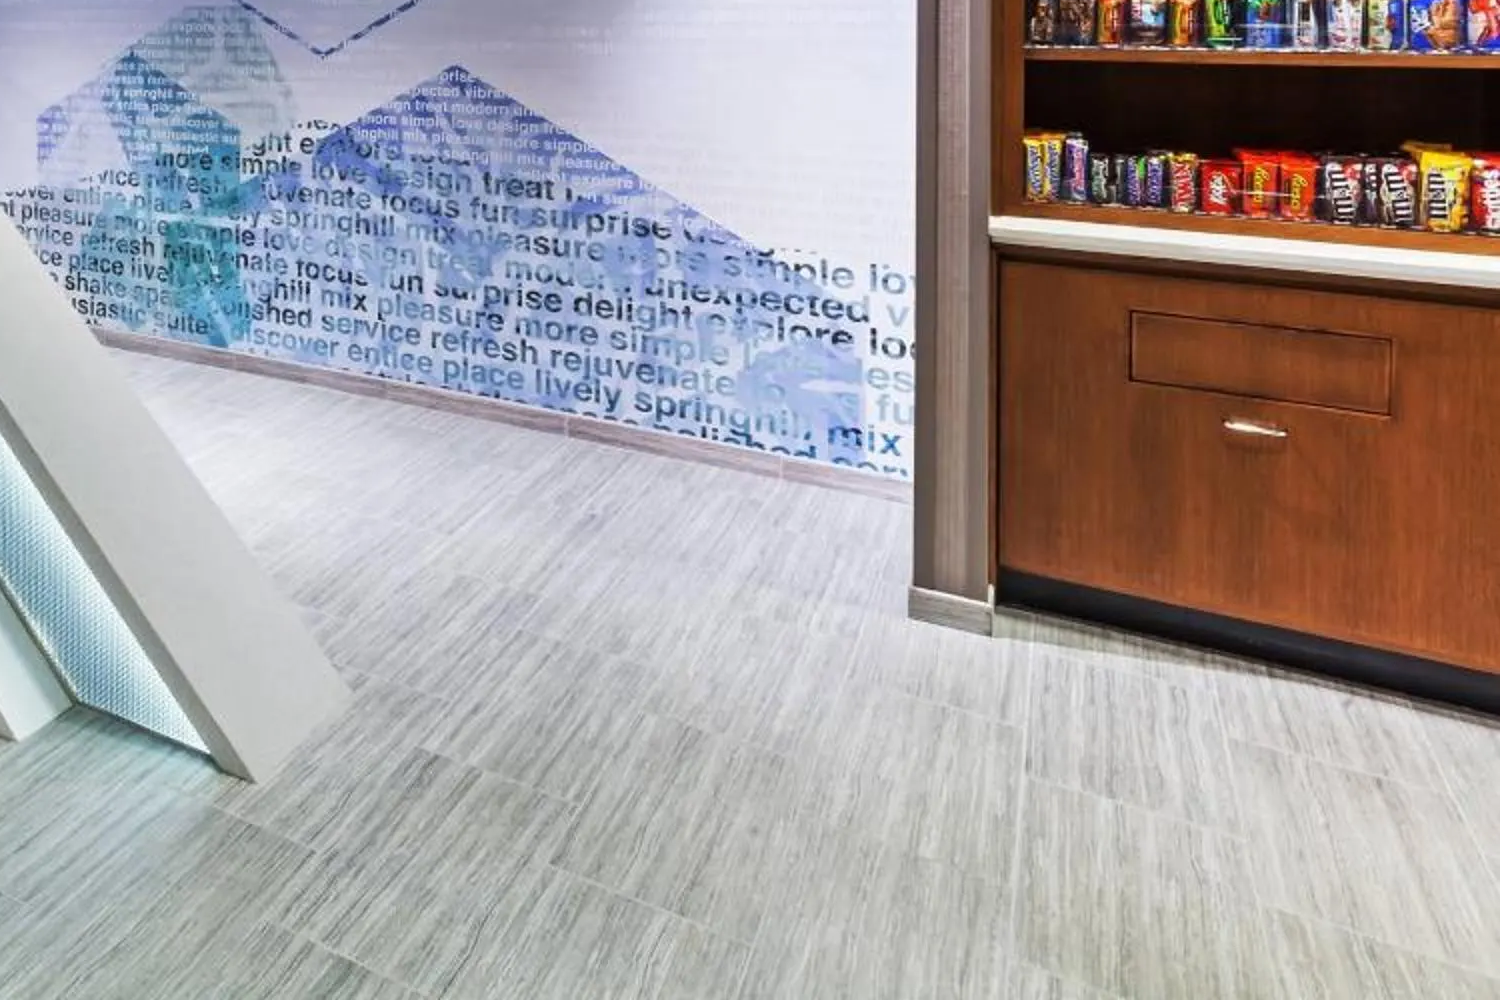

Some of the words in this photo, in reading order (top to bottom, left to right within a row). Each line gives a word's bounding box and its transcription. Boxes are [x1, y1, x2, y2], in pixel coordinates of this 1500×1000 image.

[156, 151, 213, 171] more
[221, 155, 301, 176] simple
[312, 161, 368, 184] love
[378, 165, 471, 196] design
[483, 171, 555, 201] treat
[382, 190, 460, 219] focus
[469, 197, 516, 222] fun
[21, 204, 106, 228] pleasure
[114, 216, 168, 236] more
[263, 232, 318, 253] love
[325, 238, 416, 268] design
[645, 275, 870, 324] unexpected
[82, 234, 154, 257] refresh
[296, 252, 368, 287] focus
[574, 293, 695, 333] delight
[271, 209, 395, 236] springhill
[405, 222, 455, 244] mix
[473, 230, 602, 261] pleasure
[65, 272, 127, 297] shake
[321, 314, 421, 345] service
[431, 329, 539, 364] refresh
[551, 346, 737, 397] rejuvenate
[69, 254, 124, 275] place
[320, 288, 368, 312] mix
[377, 298, 504, 332] pleasure
[516, 314, 599, 345] more
[611, 327, 730, 366] simple
[348, 342, 432, 373] entice
[442, 359, 524, 390] place
[536, 370, 621, 413] lively
[828, 424, 901, 457] mix
